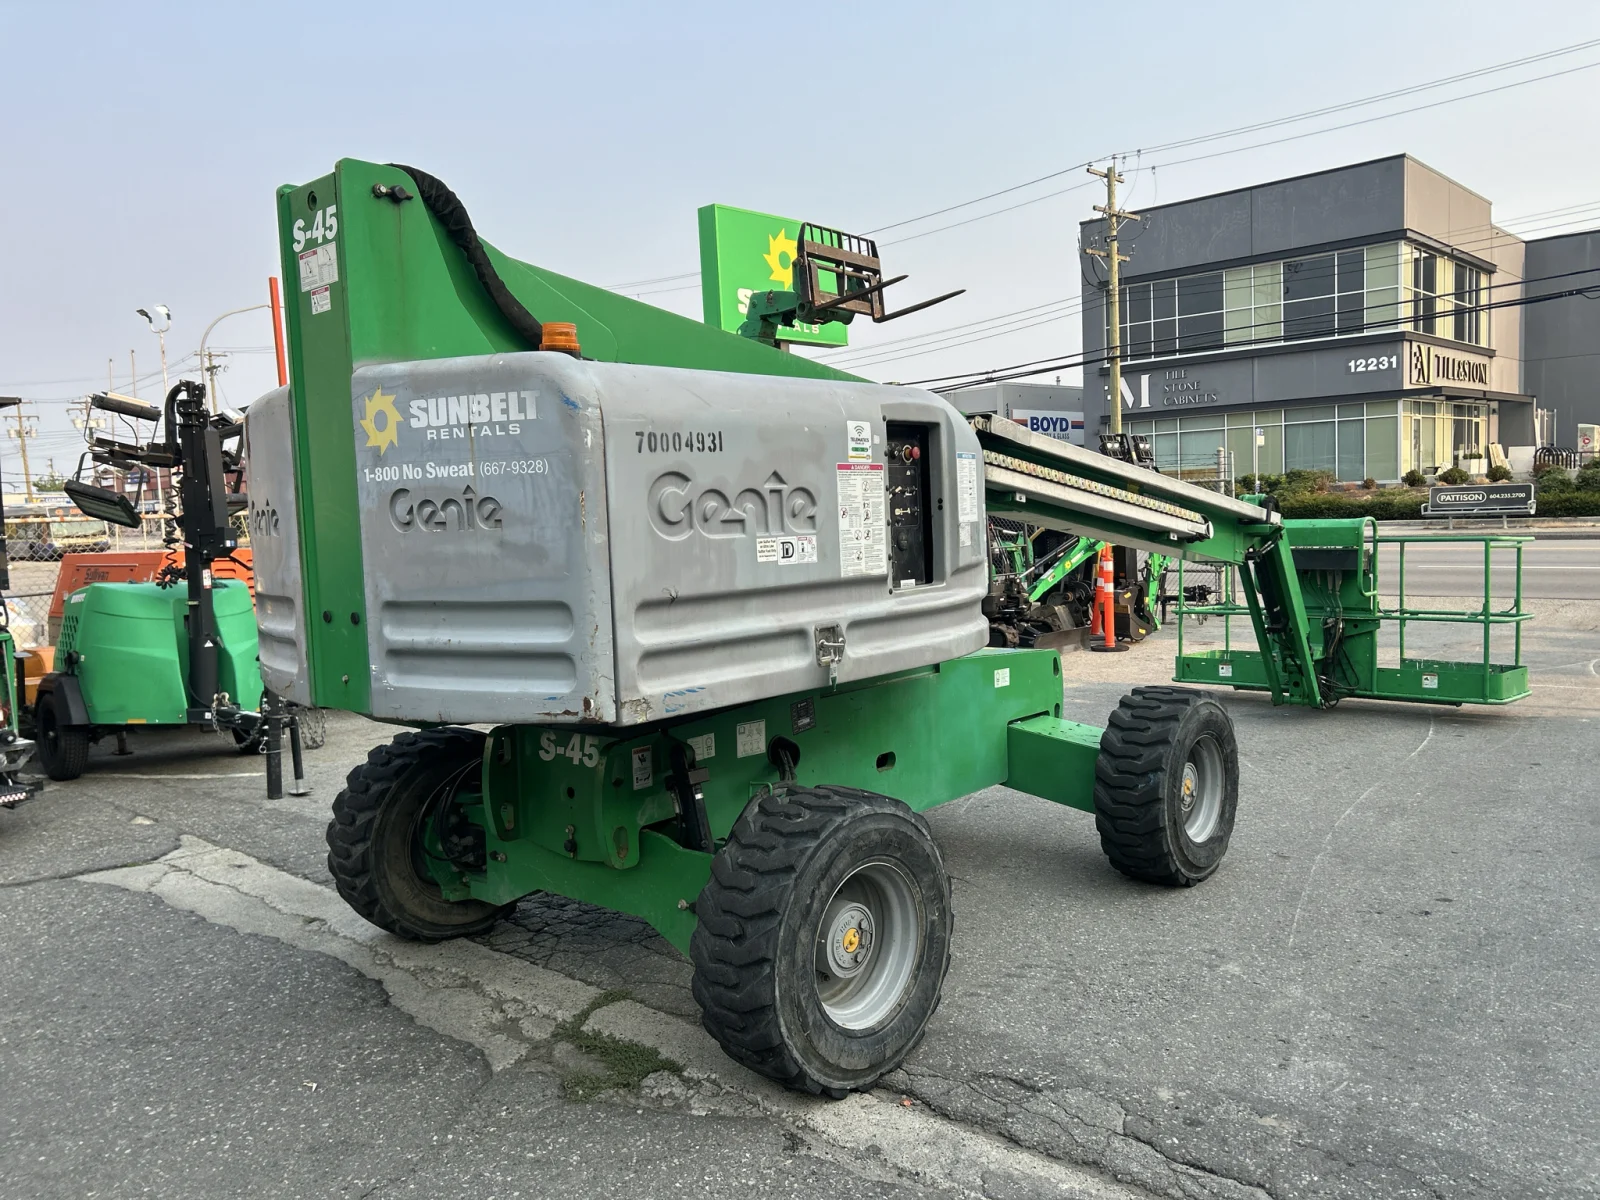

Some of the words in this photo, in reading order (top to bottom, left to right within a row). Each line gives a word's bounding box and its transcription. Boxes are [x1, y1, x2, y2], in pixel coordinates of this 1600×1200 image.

[293, 204, 338, 252] S-45
[1348, 355, 1397, 373] 12231
[1165, 369, 1188, 380] TILE
[1164, 381, 1201, 393] STONE
[1163, 393, 1217, 406] CABINETS
[409, 390, 541, 429] SUNBELT
[426, 423, 521, 441] RENTALS
[1030, 416, 1069, 432] BOYD
[635, 430, 723, 453] 70004931
[363, 466, 400, 483] 1-800
[402, 464, 423, 480] No
[426, 461, 475, 479] Sweat
[479, 458, 549, 478] (667-9328)
[648, 469, 818, 542] Genie
[1440, 493, 1483, 502] PATTISON
[389, 484, 503, 534] Genie
[780, 541, 795, 559] D
[84, 567, 110, 581] Sullivan
[538, 730, 600, 768] S-45
